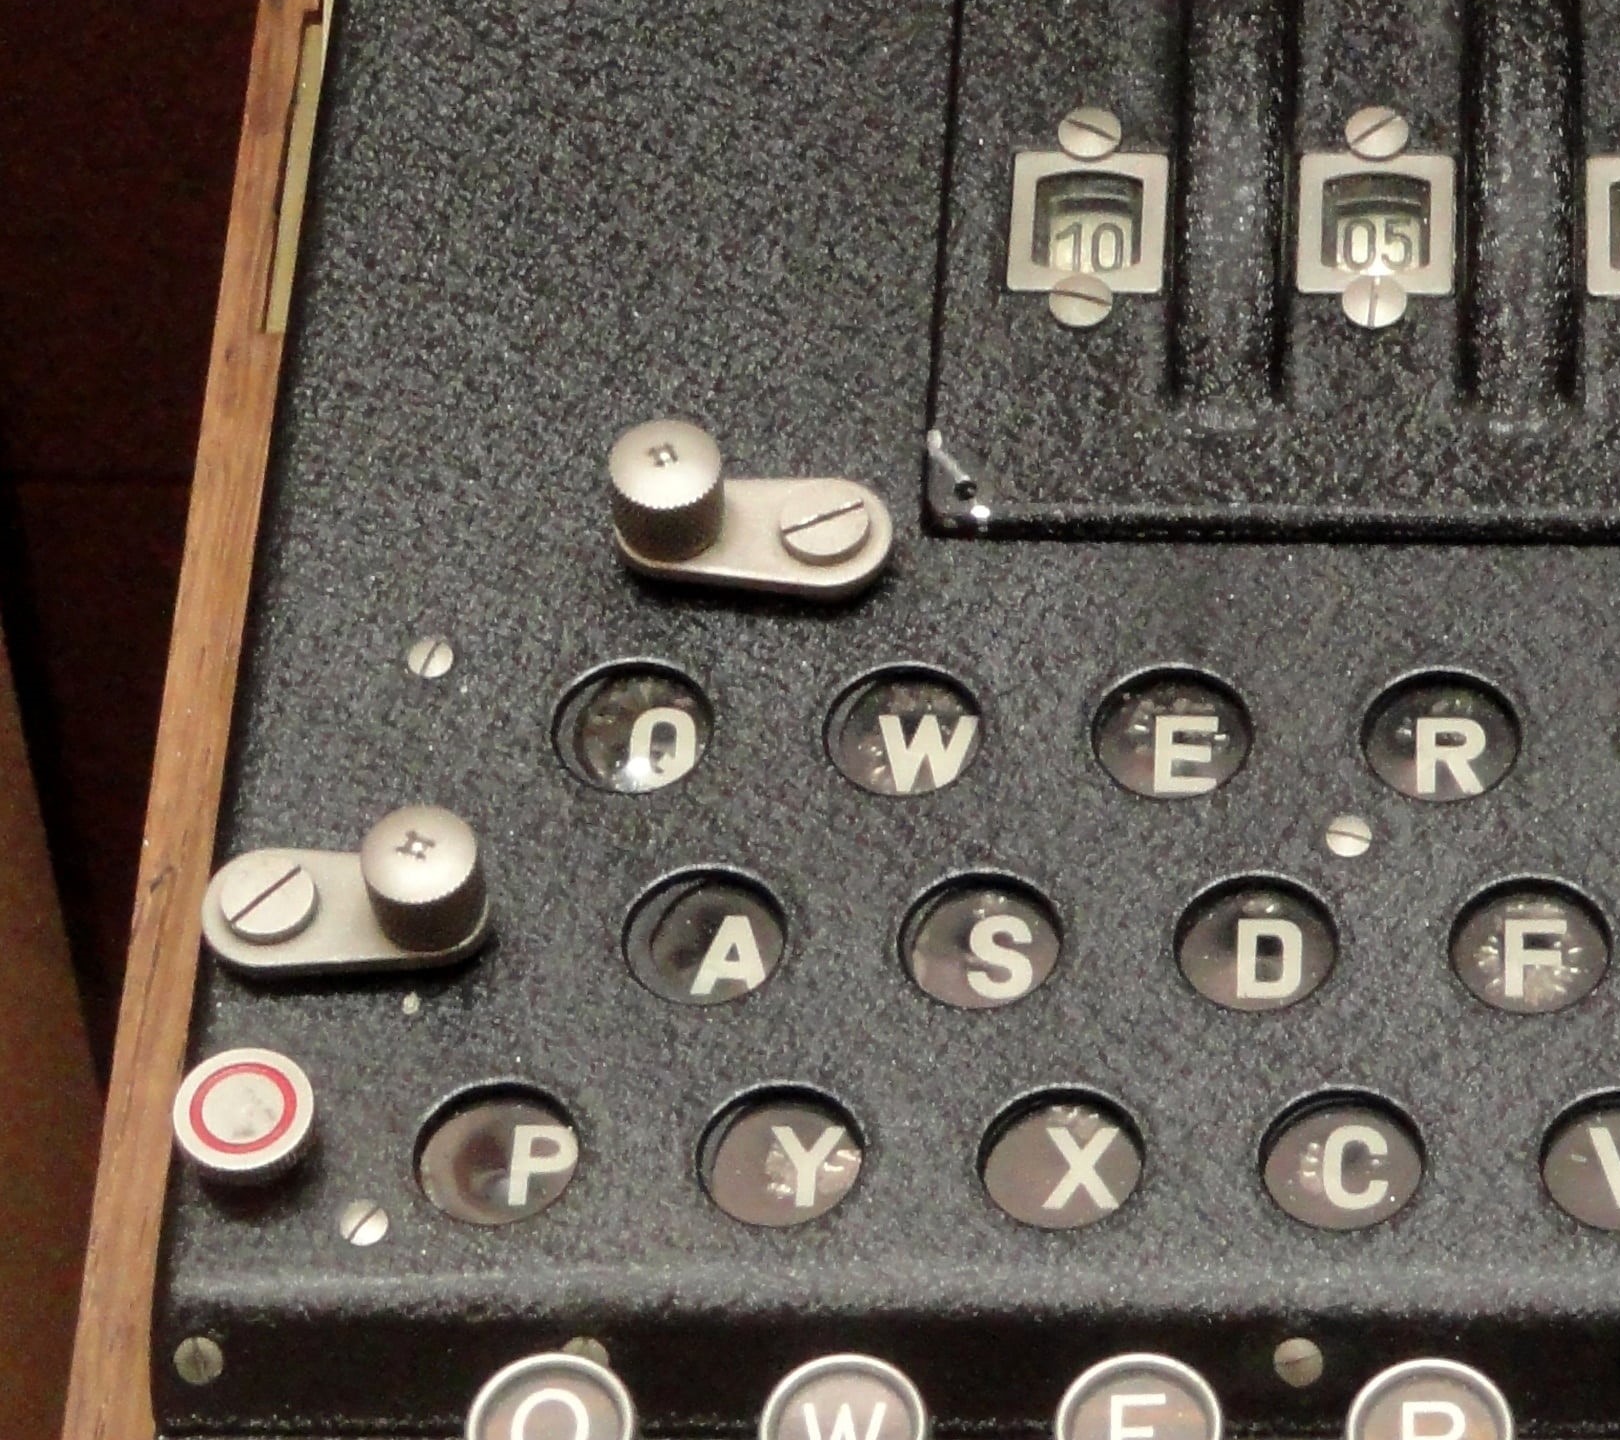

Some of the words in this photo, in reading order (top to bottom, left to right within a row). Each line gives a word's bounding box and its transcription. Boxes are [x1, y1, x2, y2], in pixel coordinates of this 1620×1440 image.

[1053, 220, 1126, 273] 10
[1340, 215, 1414, 272] 05
[879, 715, 976, 793] W
[1154, 716, 1218, 793] E
[1416, 718, 1485, 794] R
[691, 916, 766, 994] A
[967, 915, 1033, 1000] S
[1237, 920, 1302, 999] D
[1504, 919, 1567, 998] F
[506, 1125, 577, 1205] P
[770, 1127, 847, 1207] Y
[1042, 1127, 1118, 1209] X
[1320, 1126, 1390, 1210] C
